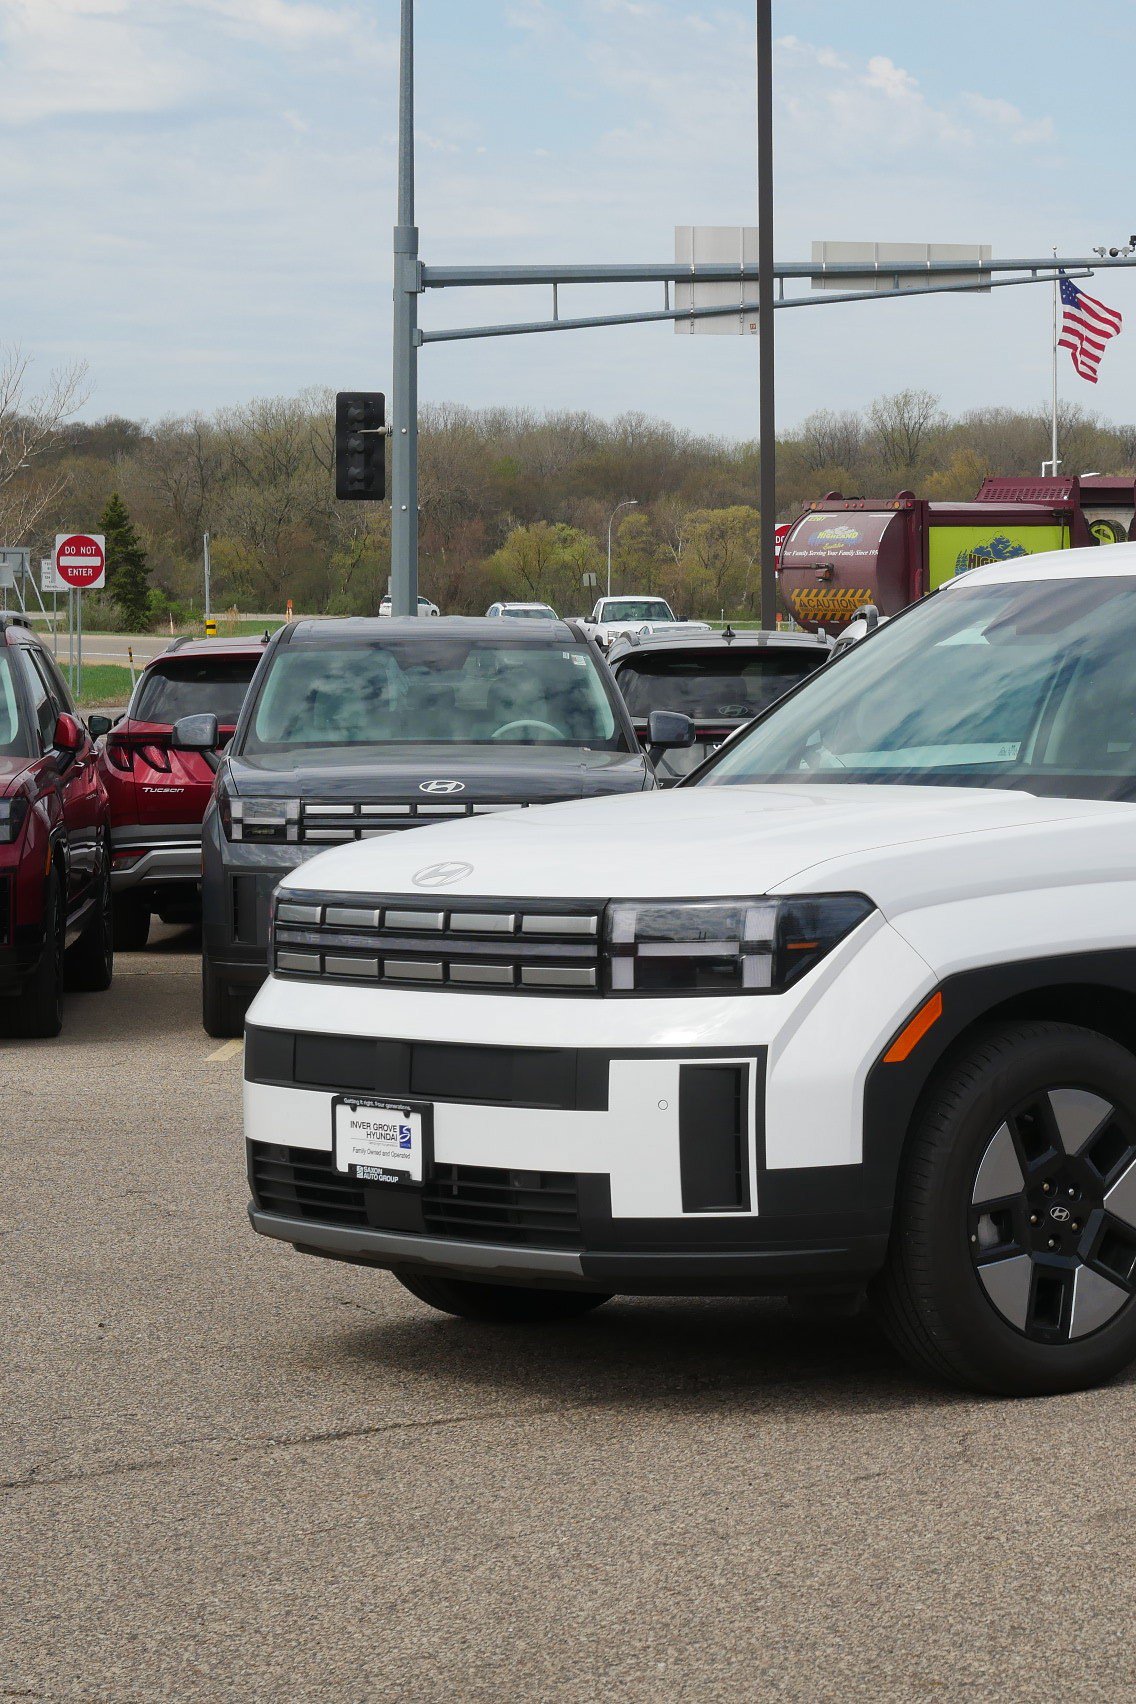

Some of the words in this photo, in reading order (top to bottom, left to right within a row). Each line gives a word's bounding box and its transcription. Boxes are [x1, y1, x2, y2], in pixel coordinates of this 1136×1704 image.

[64, 546, 76, 554] DO
[80, 546, 96, 554] NOT
[68, 568, 93, 577] ENTER
[808, 598, 857, 609] CAUTION
[350, 1121, 372, 1130] INVER
[373, 1123, 398, 1133] GROVE
[366, 1131, 398, 1142] HYUNDAI
[353, 1147, 366, 1155] Family
[367, 1148, 381, 1156] Owned
[391, 1151, 411, 1159] Operated
[364, 1173, 379, 1181] AUTO
[379, 1175, 399, 1183] GROUP
